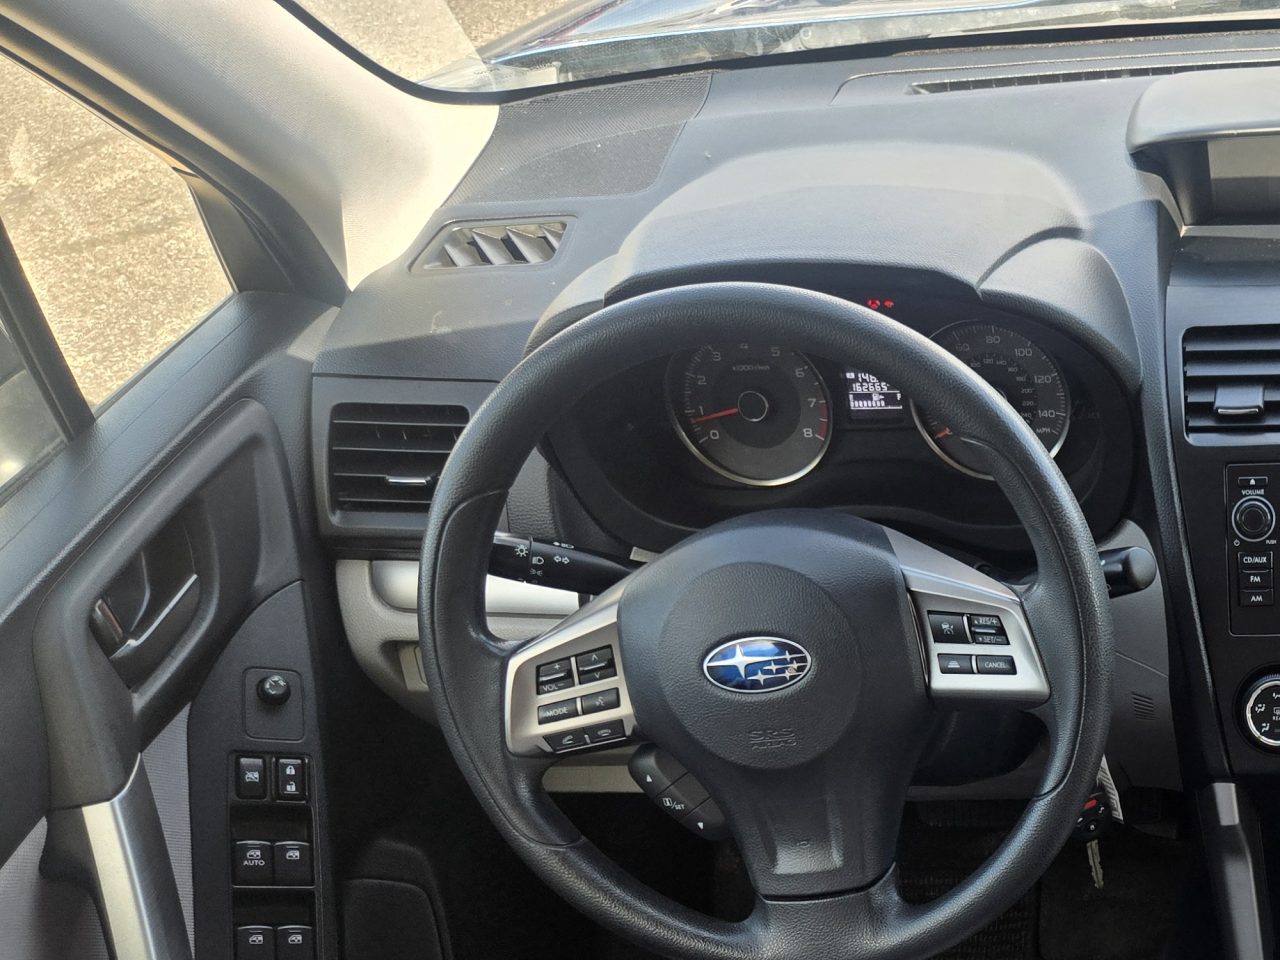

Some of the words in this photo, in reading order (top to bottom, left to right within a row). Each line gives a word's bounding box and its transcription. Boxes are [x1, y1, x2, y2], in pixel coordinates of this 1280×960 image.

[1014, 348, 1033, 357] 100
[1034, 375, 1052, 384] 120
[807, 398, 817, 408] 7
[1038, 409, 1056, 418] 140
[710, 430, 720, 440] 0
[803, 428, 813, 438] 8
[1241, 488, 1265, 496] VOLUME
[1243, 556, 1267, 564] CD/AUX
[984, 661, 1007, 669] CANCEL
[544, 706, 569, 718] MODE
